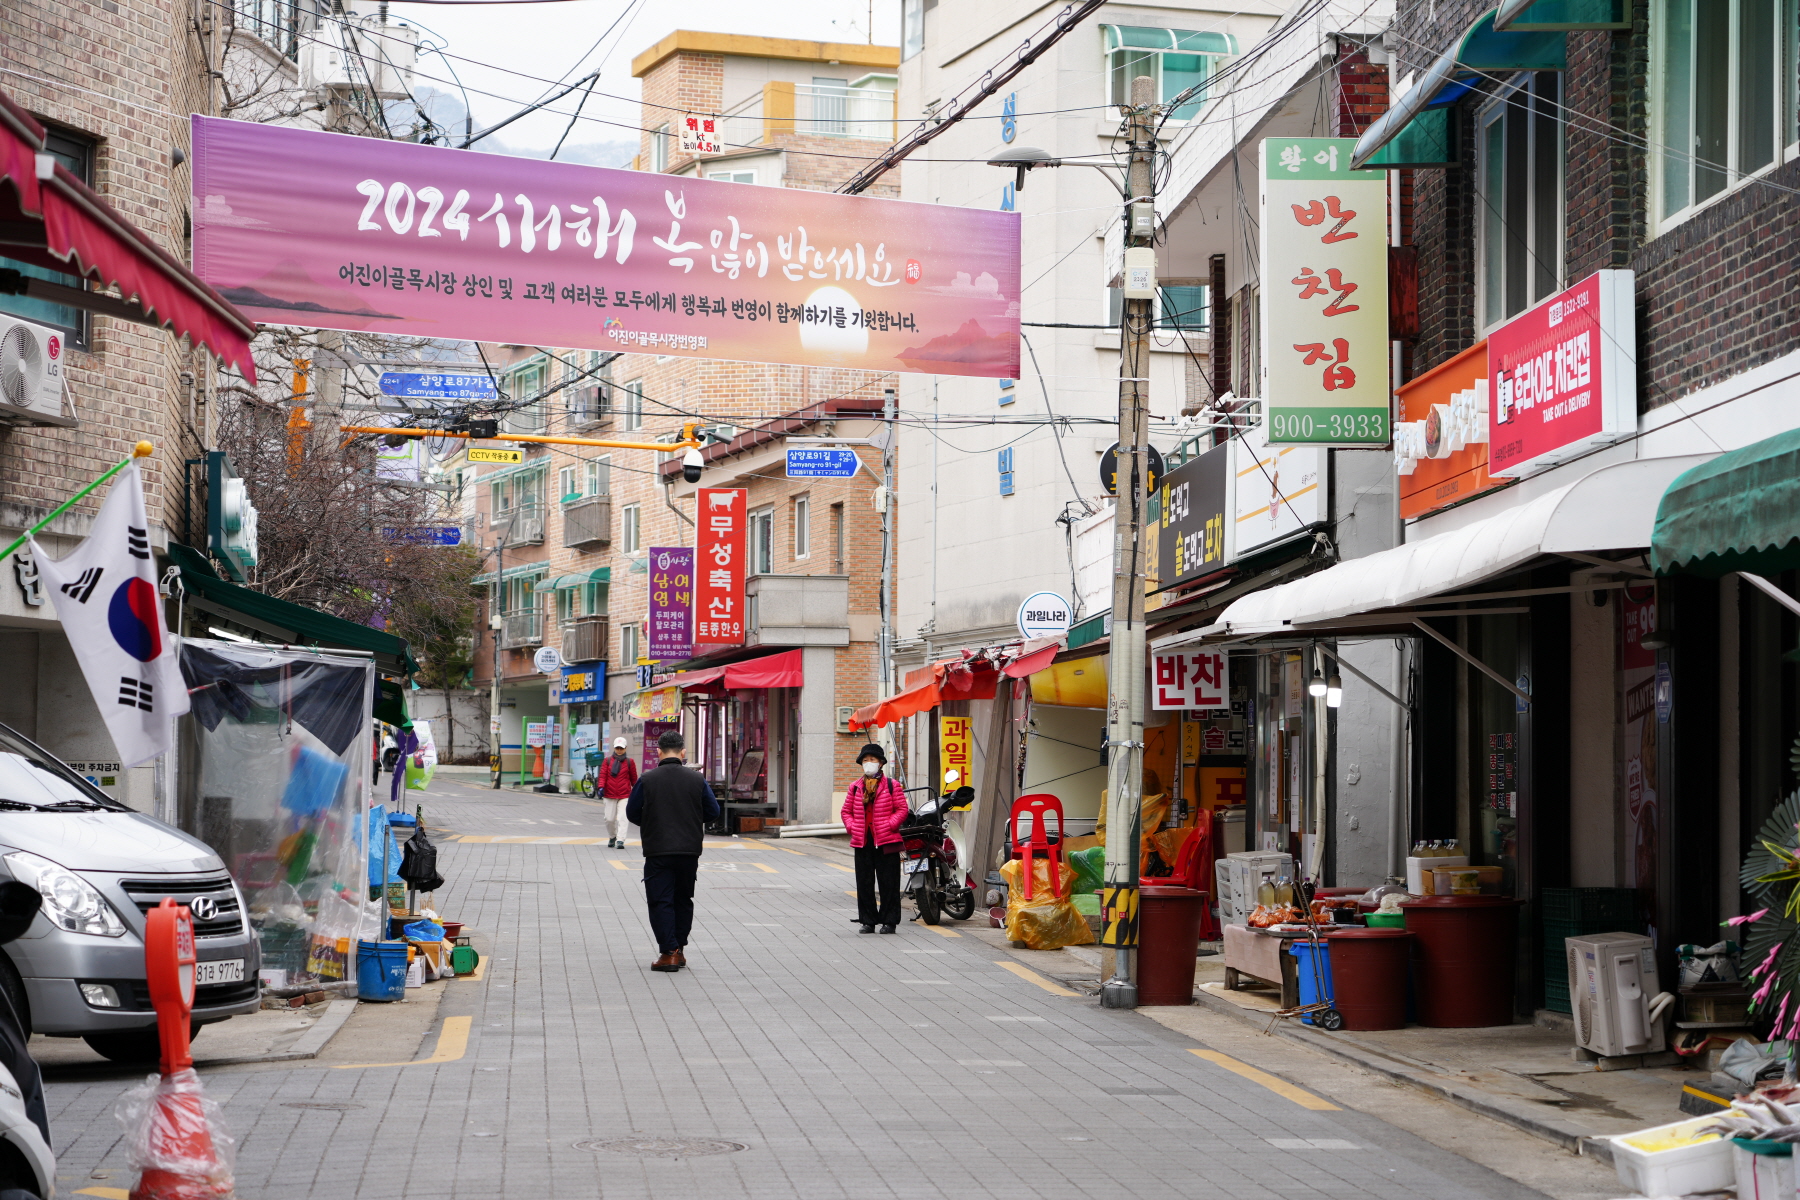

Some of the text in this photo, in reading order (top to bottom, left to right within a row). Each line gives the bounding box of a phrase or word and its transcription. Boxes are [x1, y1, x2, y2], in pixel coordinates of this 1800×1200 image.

[696, 131, 706, 142] kt
[1278, 145, 1373, 172] 환이
[355, 178, 900, 287] 2024 새해 복 많이 받으세요
[338, 262, 920, 333] 어진이골목시장 상인 및 고객 여러분 모두에게 행복과 번영이 함께하기를 기원합니다.
[1291, 195, 1360, 391] 반찬집
[608, 328, 708, 349] 어진이골목시장번영회
[47, 363, 58, 377] LG
[1514, 330, 1591, 415] 후라이드 치킨집
[419, 375, 495, 389] 삼양로87가길
[406, 387, 495, 399] Samyang-ro 87ga-gil
[1542, 407, 1554, 424] TAKE
[1554, 402, 1564, 419] OUT
[1568, 390, 1591, 414] DELIVERY
[1273, 414, 1383, 438] 900-3933
[470, 451, 510, 461] CCTV 작동중
[789, 451, 831, 461] 삼양로91길
[789, 461, 842, 469] Samyang-ro 91-gil
[1162, 481, 1190, 529] 밥도먹고
[708, 516, 734, 619] 무성축산
[653, 591, 691, 608] 염색
[655, 611, 685, 620] 두피케어
[1026, 610, 1067, 622] 과일나라
[1625, 610, 1637, 626] TAKE
[655, 621, 685, 630] 탈모관리
[698, 621, 741, 638] 토종한우
[1626, 628, 1637, 644] OUT
[1156, 653, 1224, 706] 반찬
[1657, 680, 1670, 702] ADT
[88, 763, 120, 772] 주차금지
[1489, 733, 1497, 810] 각종김치
[1497, 732, 1505, 810] 마른반찬
[1629, 789, 1641, 802] FRIED
[218, 962, 240, 980] 9776
